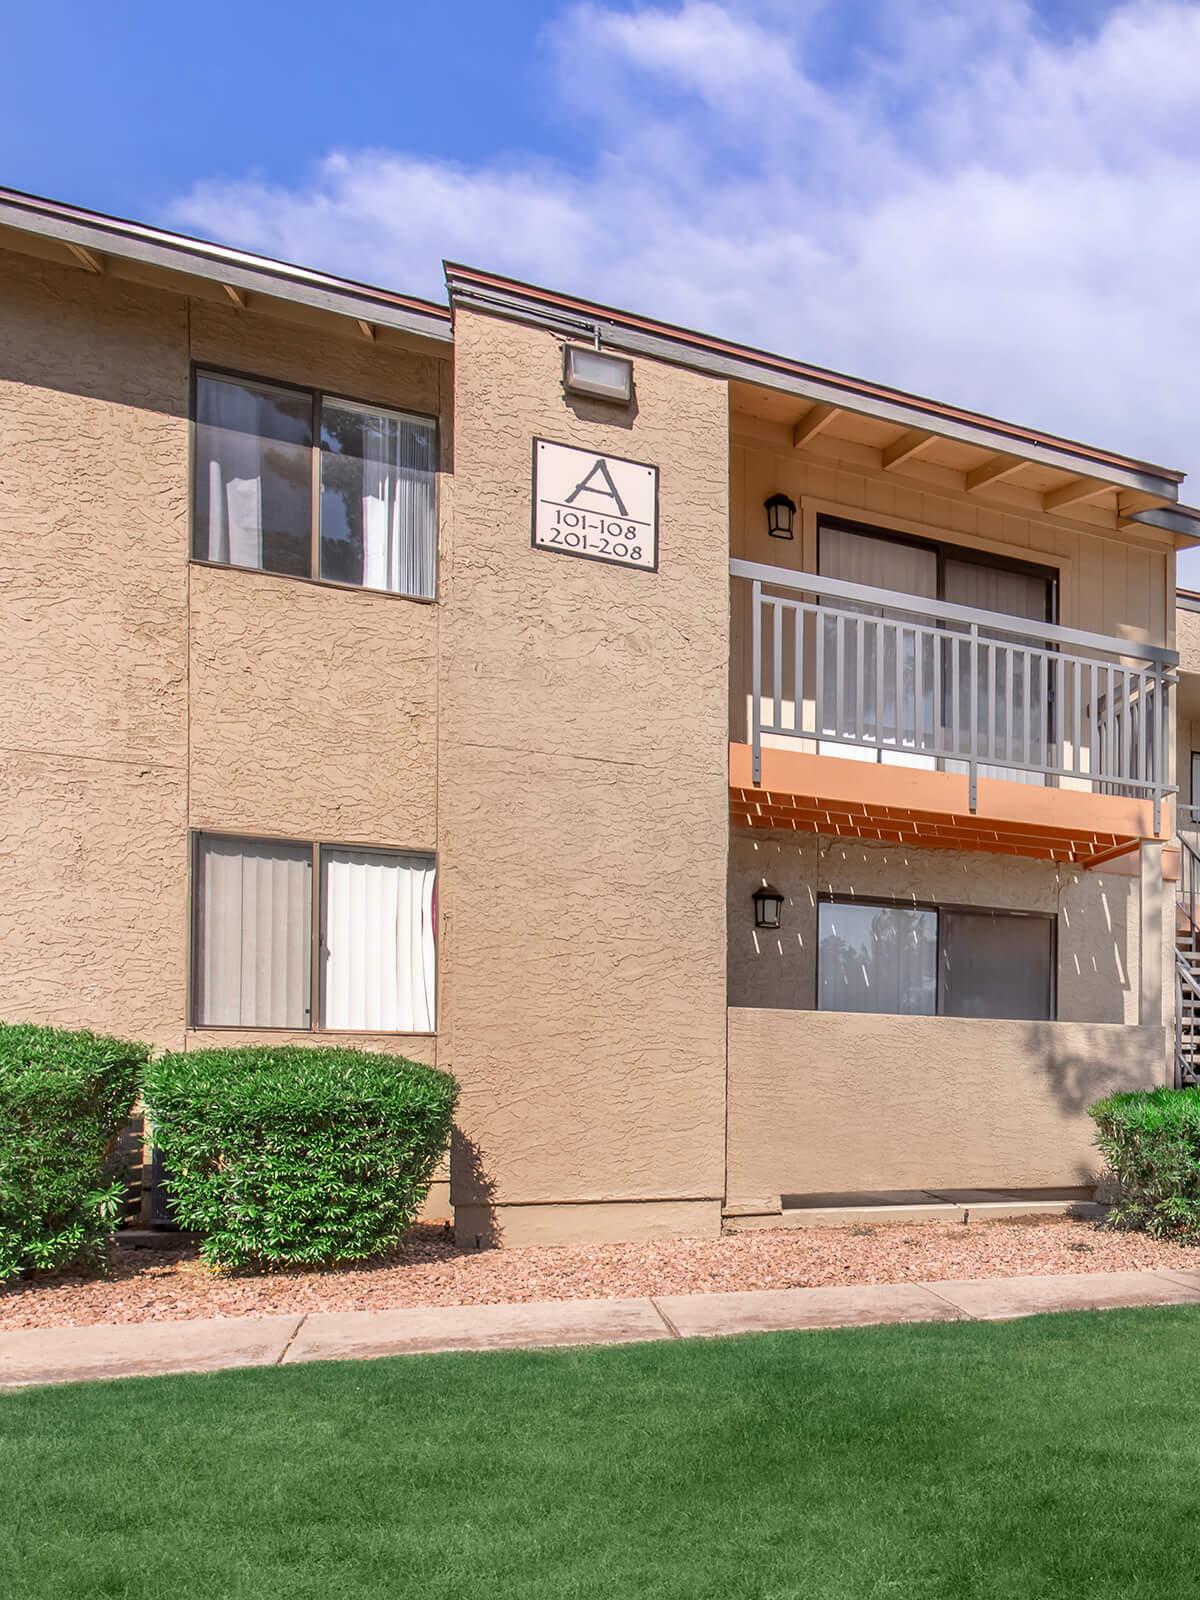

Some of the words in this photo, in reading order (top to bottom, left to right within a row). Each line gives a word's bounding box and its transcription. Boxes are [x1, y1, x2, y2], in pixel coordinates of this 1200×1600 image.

[564, 458, 629, 516] A
[555, 509, 637, 540] 101-108
[549, 527, 642, 560] 201-208
